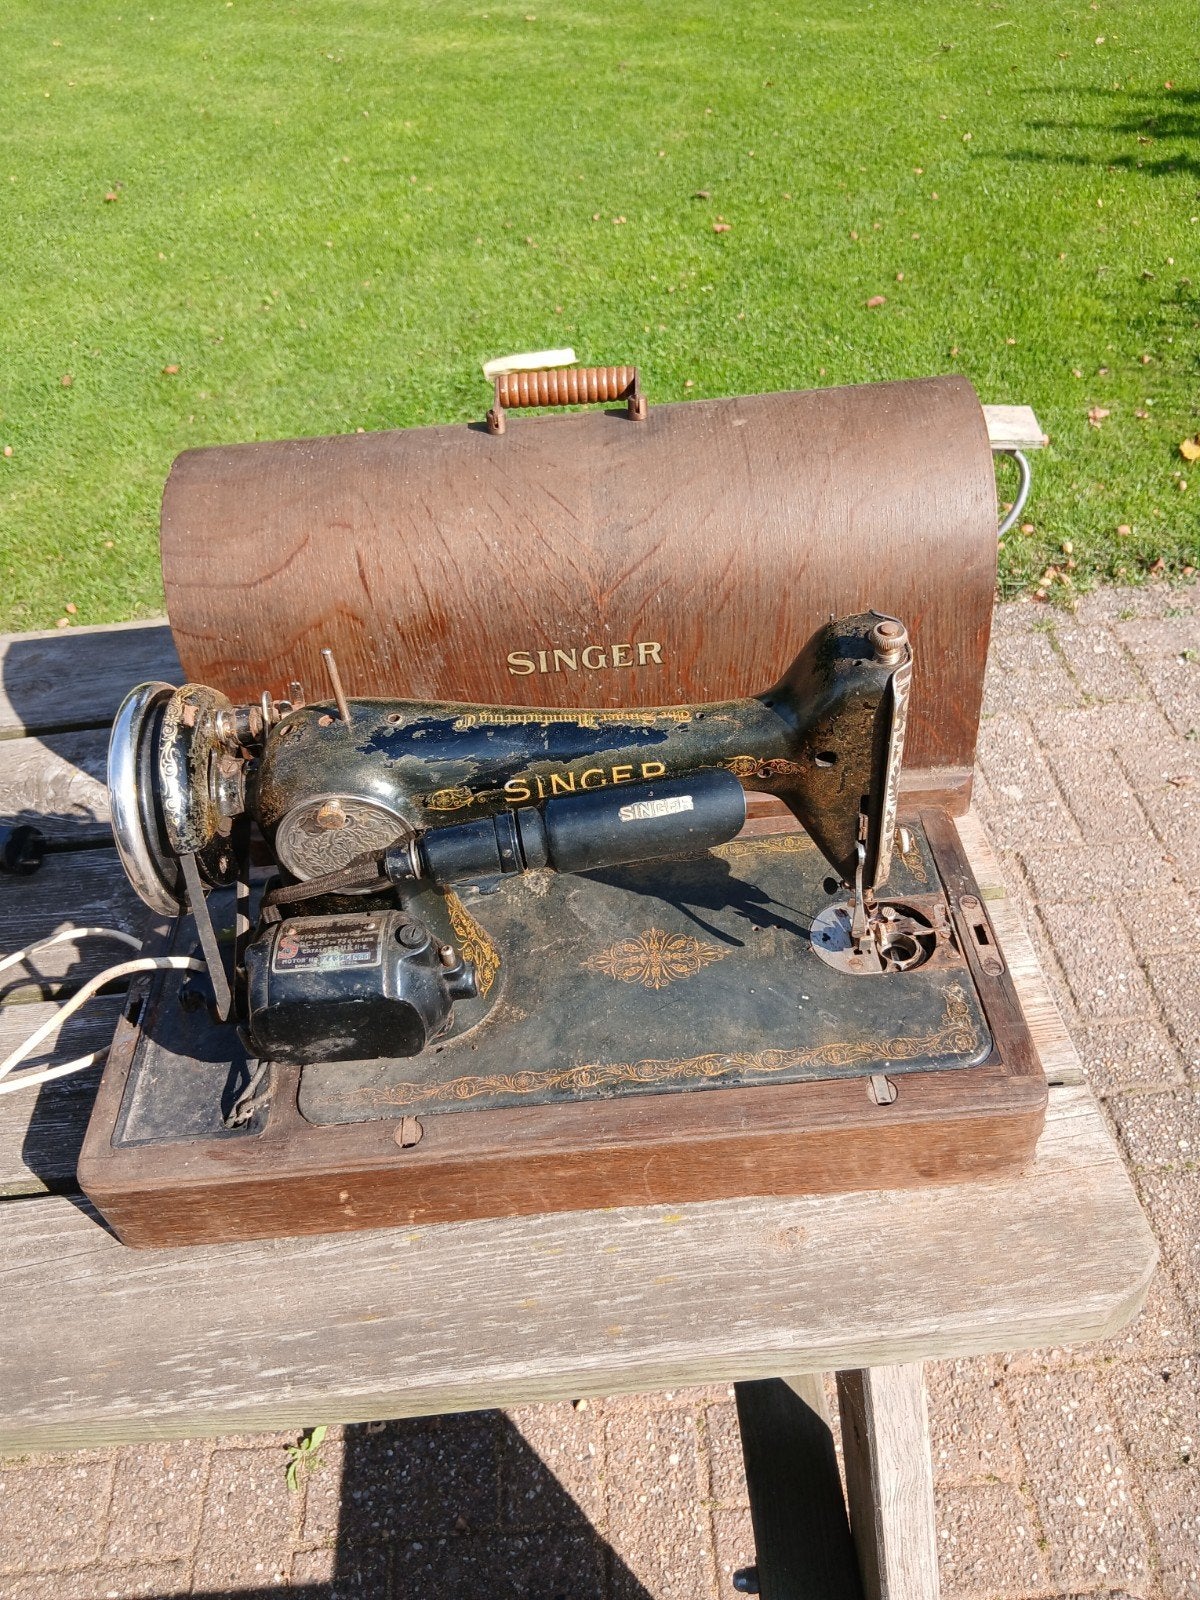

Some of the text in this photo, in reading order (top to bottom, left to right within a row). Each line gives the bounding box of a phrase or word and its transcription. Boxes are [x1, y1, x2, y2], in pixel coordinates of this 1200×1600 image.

[506, 641, 663, 676] SINGER
[479, 711, 599, 728] Manufacturing
[599, 711, 657, 725] Singer
[281, 957, 306, 965] MOTOR
